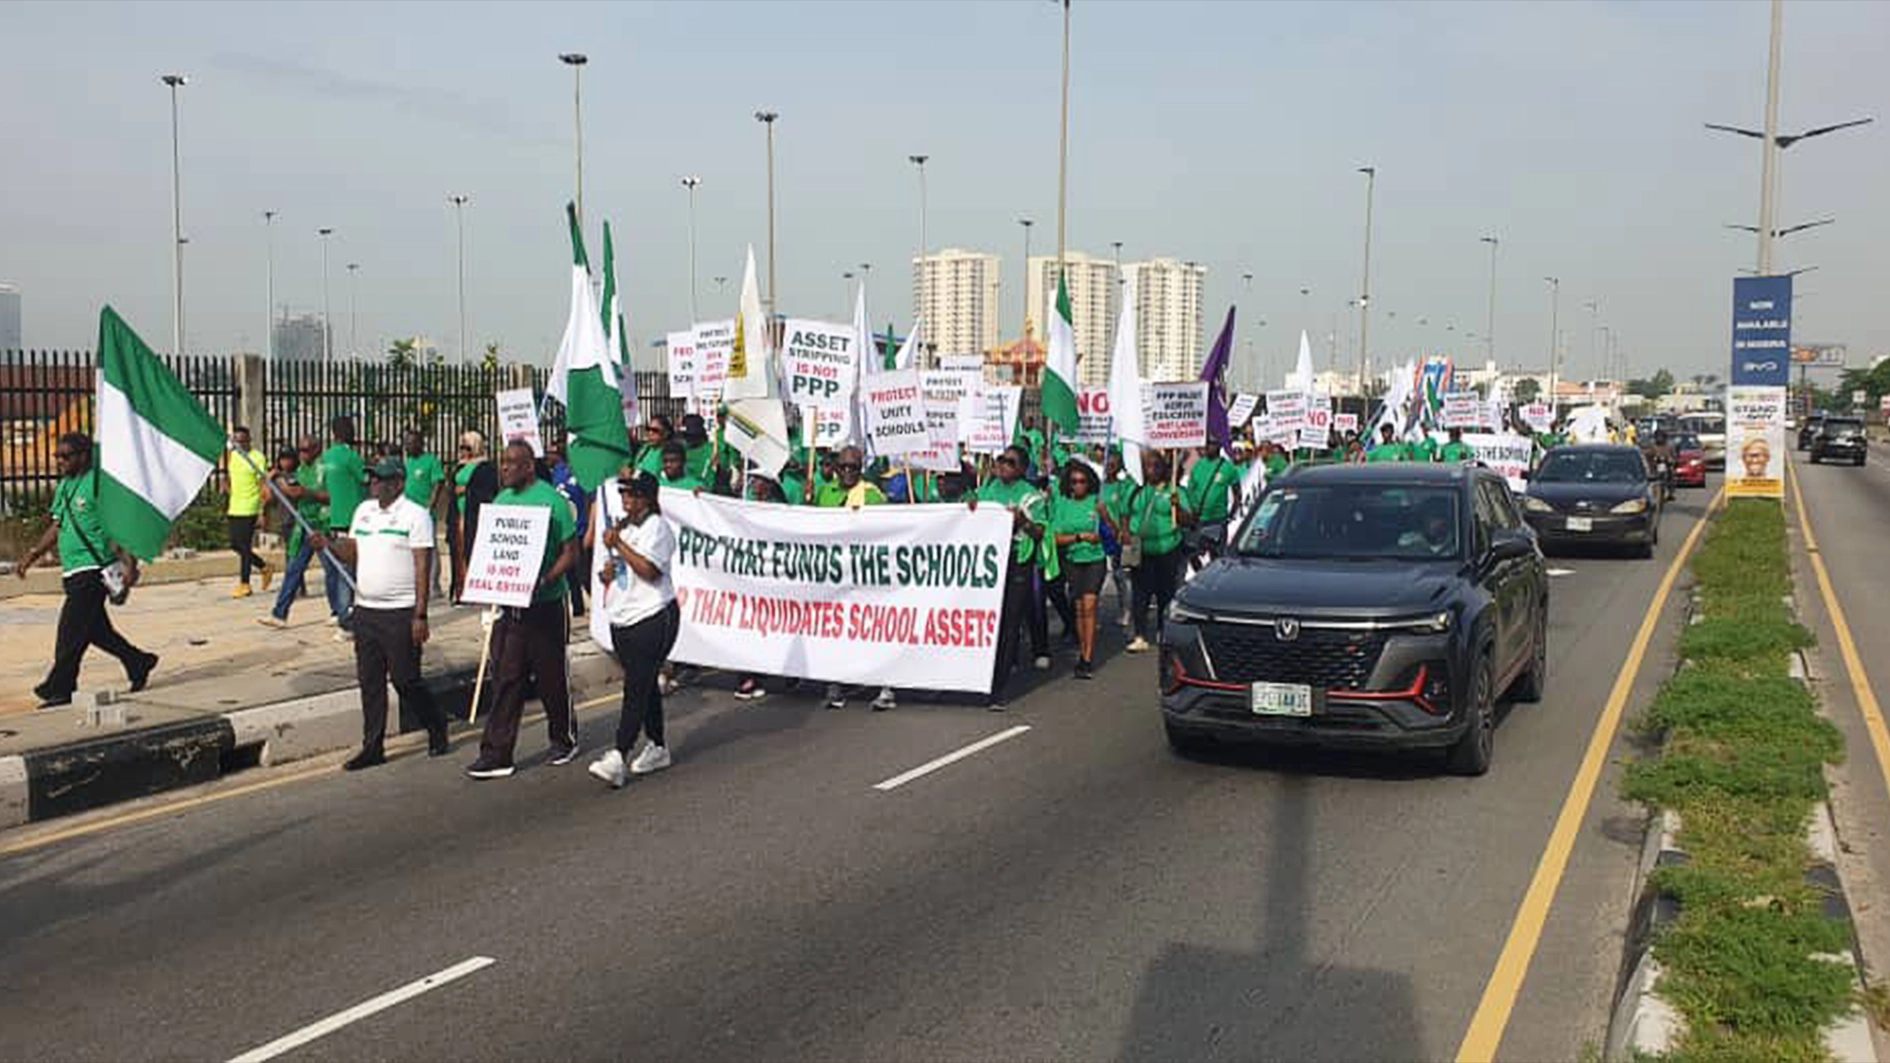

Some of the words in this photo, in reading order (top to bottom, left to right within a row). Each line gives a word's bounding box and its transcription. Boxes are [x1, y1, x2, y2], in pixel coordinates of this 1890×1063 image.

[791, 330, 851, 352] ASSET
[789, 347, 851, 365] STRIPPING
[796, 362, 809, 374] IS
[812, 364, 839, 378] NOT
[792, 375, 839, 398] PPP
[870, 386, 917, 404] PROTECT
[1077, 392, 1110, 414] NO
[881, 405, 912, 419] UNITY
[1152, 411, 1204, 420] EDUCATION
[1307, 410, 1327, 427] NO
[875, 421, 926, 437] SCHOOLS
[495, 518, 532, 530] PUBLIC
[489, 533, 529, 546] SCHOOL
[493, 549, 520, 561] LAND
[678, 526, 717, 569] PPP
[718, 535, 768, 577] THAT
[771, 541, 843, 584] FUNDS
[850, 544, 891, 586] THE
[896, 544, 998, 588] SCHOOLS
[487, 564, 497, 576] IS
[498, 565, 521, 577] NOT
[691, 589, 736, 627] THAT
[738, 597, 844, 638] LIQUIDATES
[847, 603, 918, 645] SCHOOL
[923, 606, 996, 647] ASSETS
